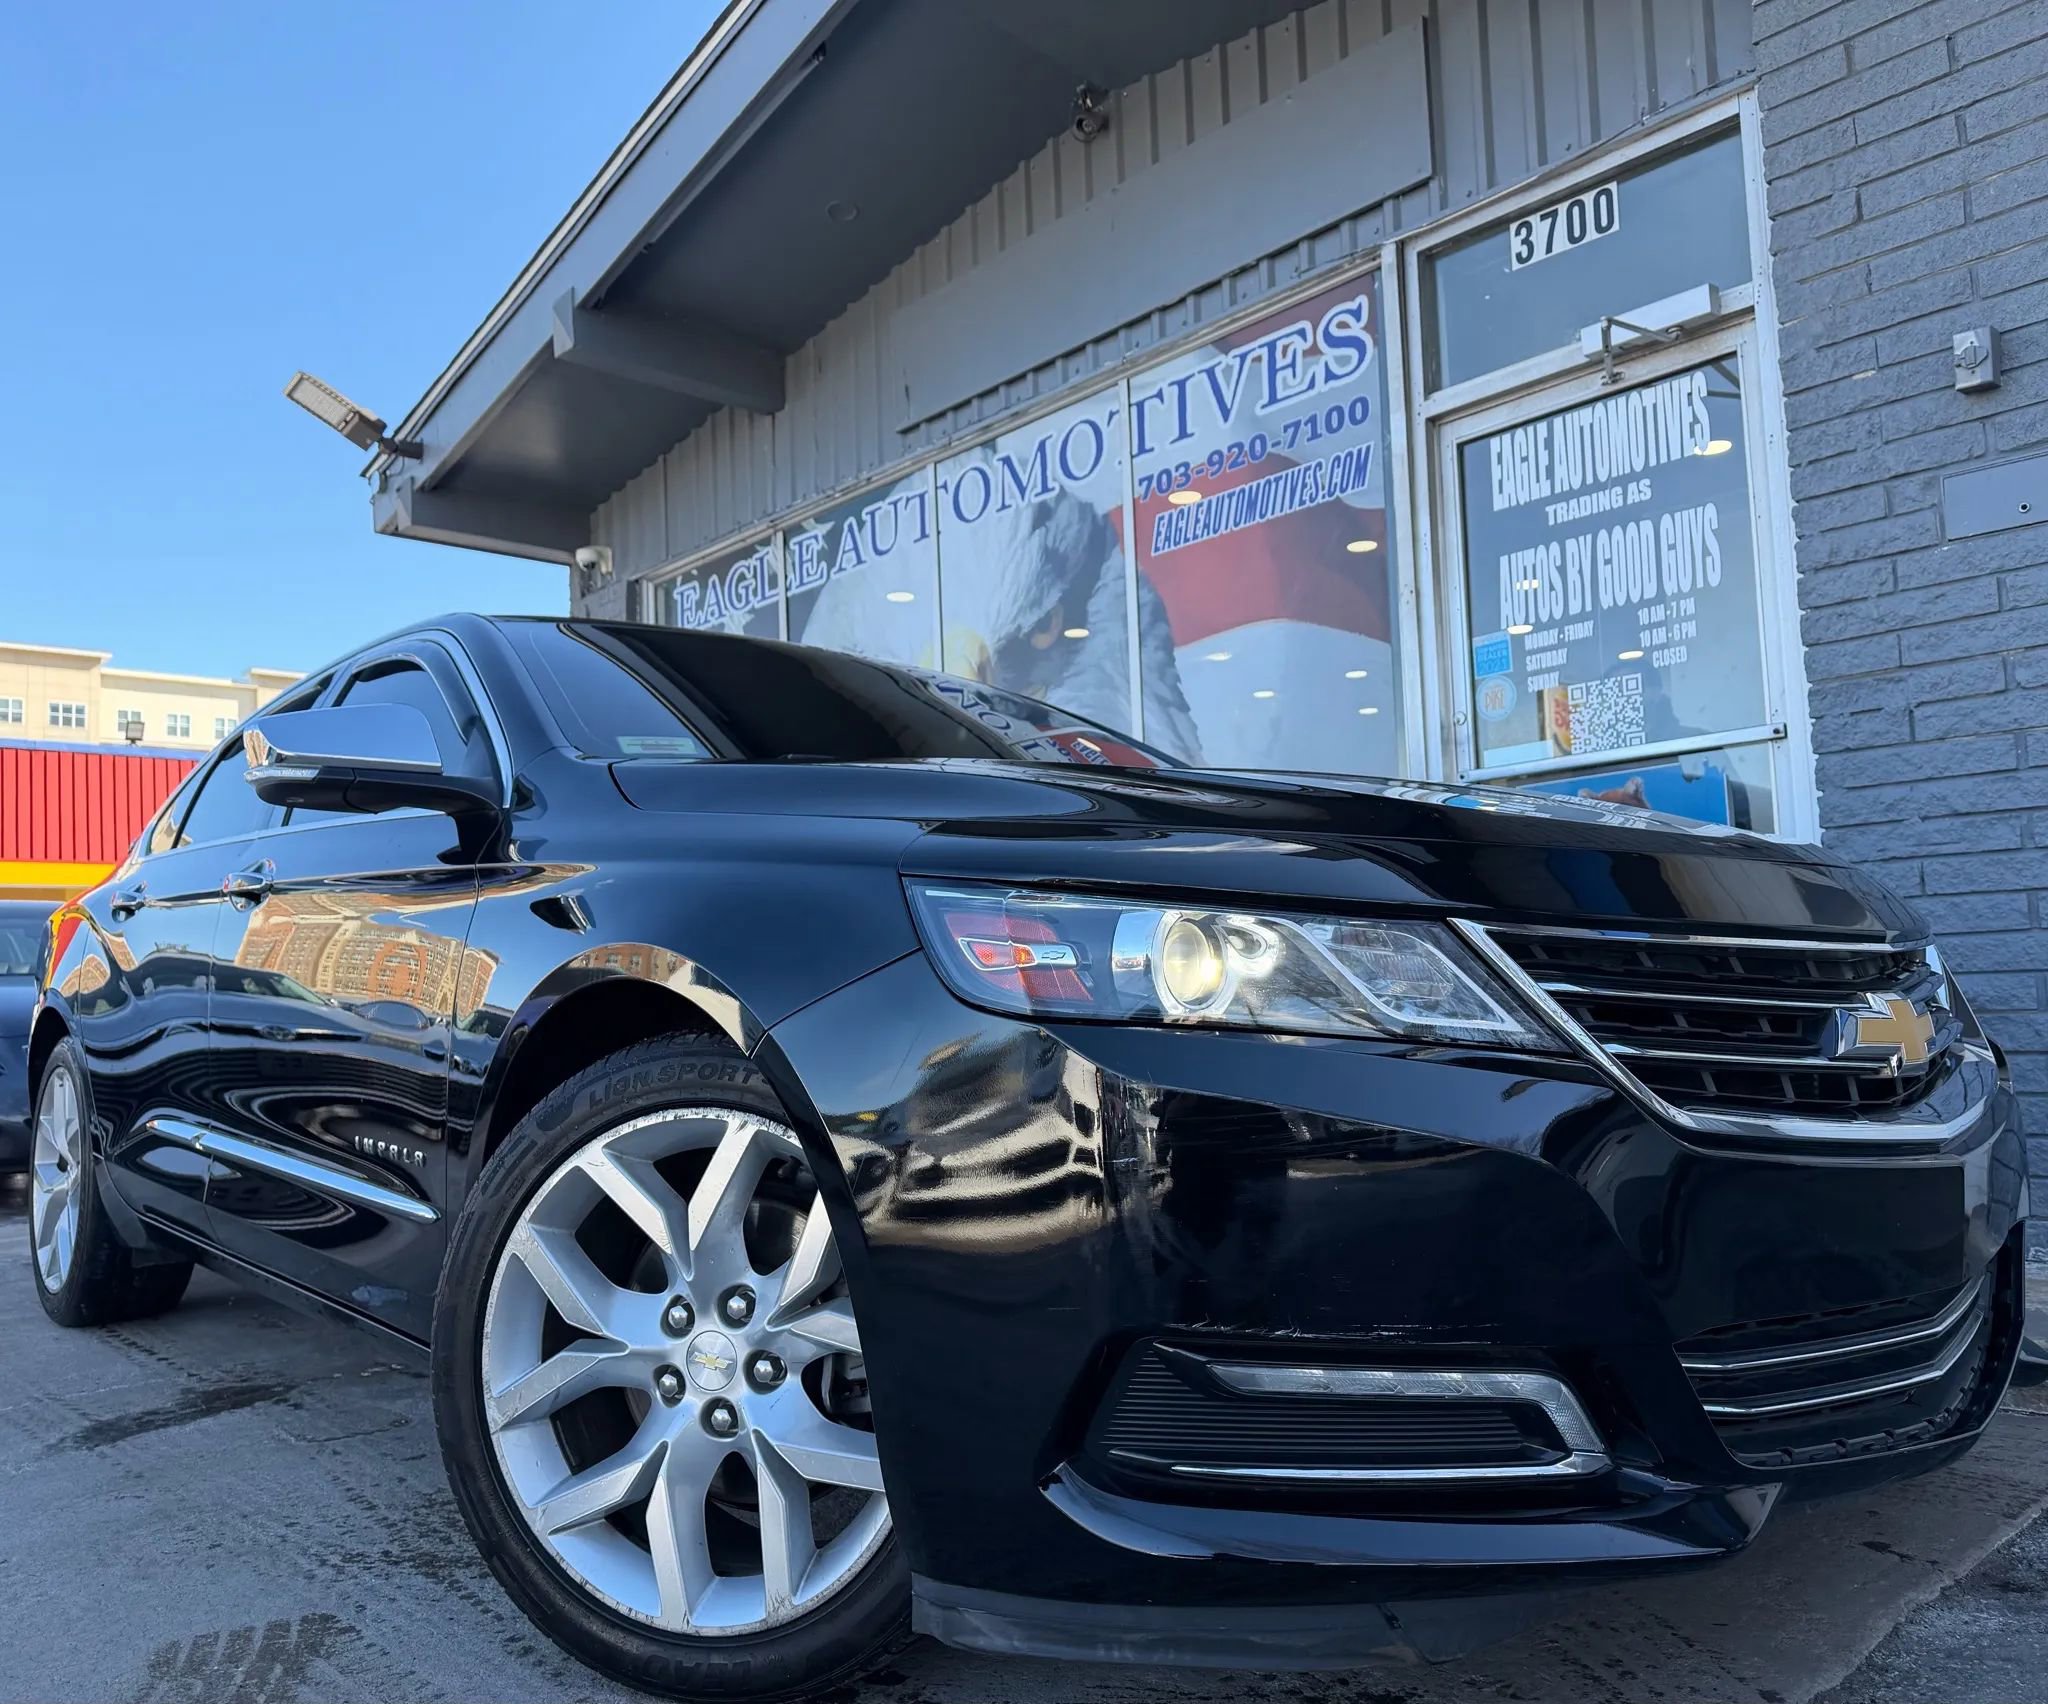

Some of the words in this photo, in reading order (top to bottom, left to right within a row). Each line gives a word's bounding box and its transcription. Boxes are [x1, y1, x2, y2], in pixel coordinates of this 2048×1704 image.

[1514, 187, 1615, 265] 3700
[675, 530, 829, 629] EAGLE
[831, 295, 1374, 577] AUTOMOTIVES
[1138, 396, 1370, 502] 703-920-7100
[1490, 421, 1551, 511] EAGLE
[1553, 371, 1711, 493] AUTOMOTIVES
[1151, 441, 1374, 557] EAGLEAUTOMOTIVES.COM
[1545, 486, 1624, 526] TRADING
[1626, 478, 1652, 504] AS
[1500, 541, 1564, 630] AUTOS
[1565, 532, 1596, 616] BY
[1597, 519, 1658, 610] GOOD
[1660, 503, 1721, 597] GUYS
[1524, 628, 1559, 651] MONDAY
[1564, 620, 1594, 642] FRIDAY
[1637, 607, 1649, 626] 10
[1650, 603, 1666, 623] AM
[1671, 600, 1677, 618] 7
[1680, 597, 1696, 617] PM
[1639, 629, 1651, 648] 10
[1652, 626, 1667, 646] AM
[1673, 623, 1681, 641] 6
[1681, 620, 1697, 640] PM
[1526, 647, 1568, 672] SATURDAY
[1652, 645, 1688, 669] CLOSED
[1527, 671, 1560, 693] SUNDAY
